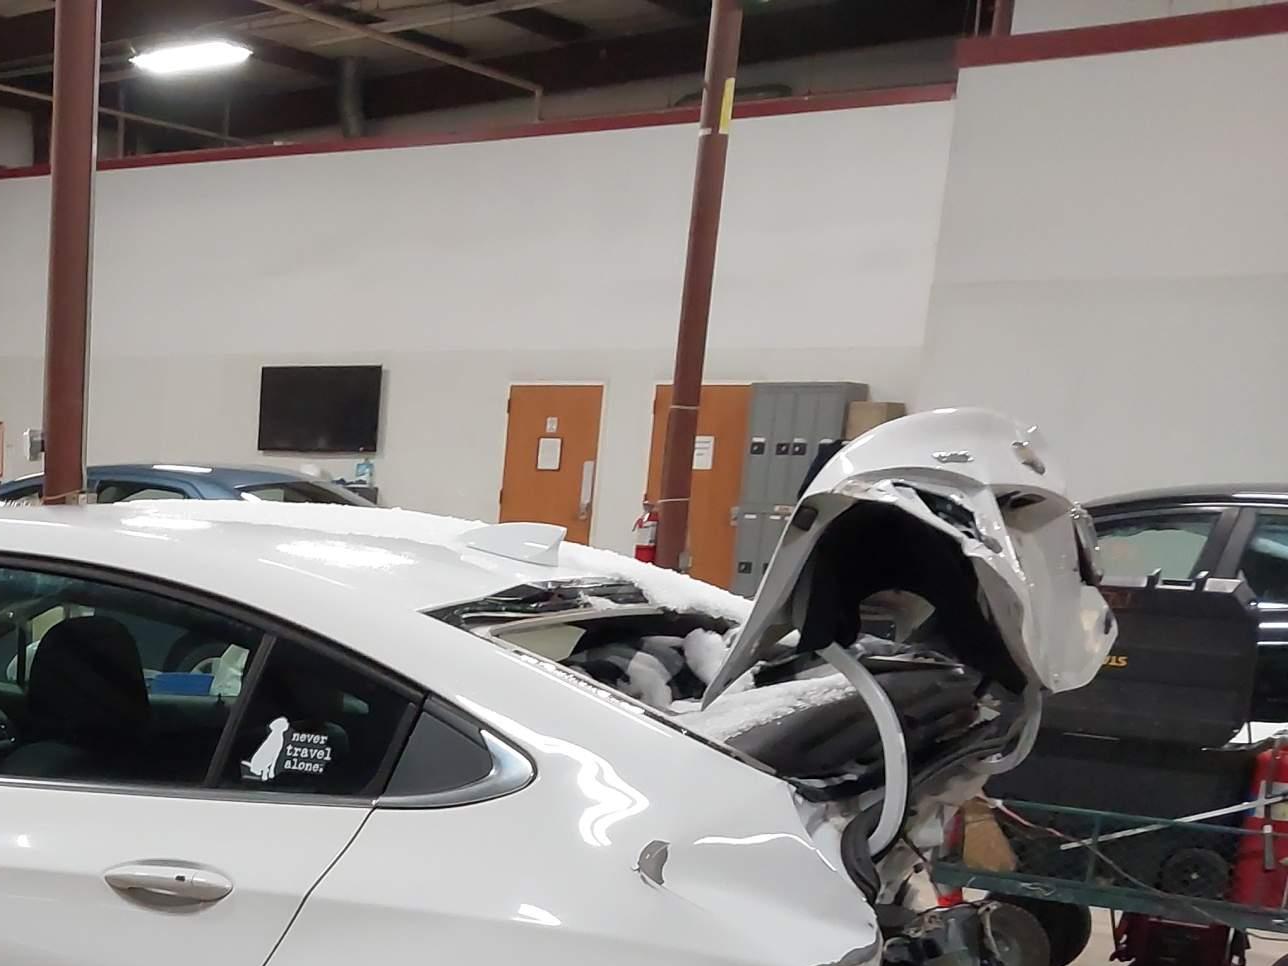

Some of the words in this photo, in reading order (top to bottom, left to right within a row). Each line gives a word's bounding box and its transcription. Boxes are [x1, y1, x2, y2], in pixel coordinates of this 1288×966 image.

[292, 733, 328, 744] never
[286, 744, 331, 760] travel
[284, 758, 324, 772] alone.
